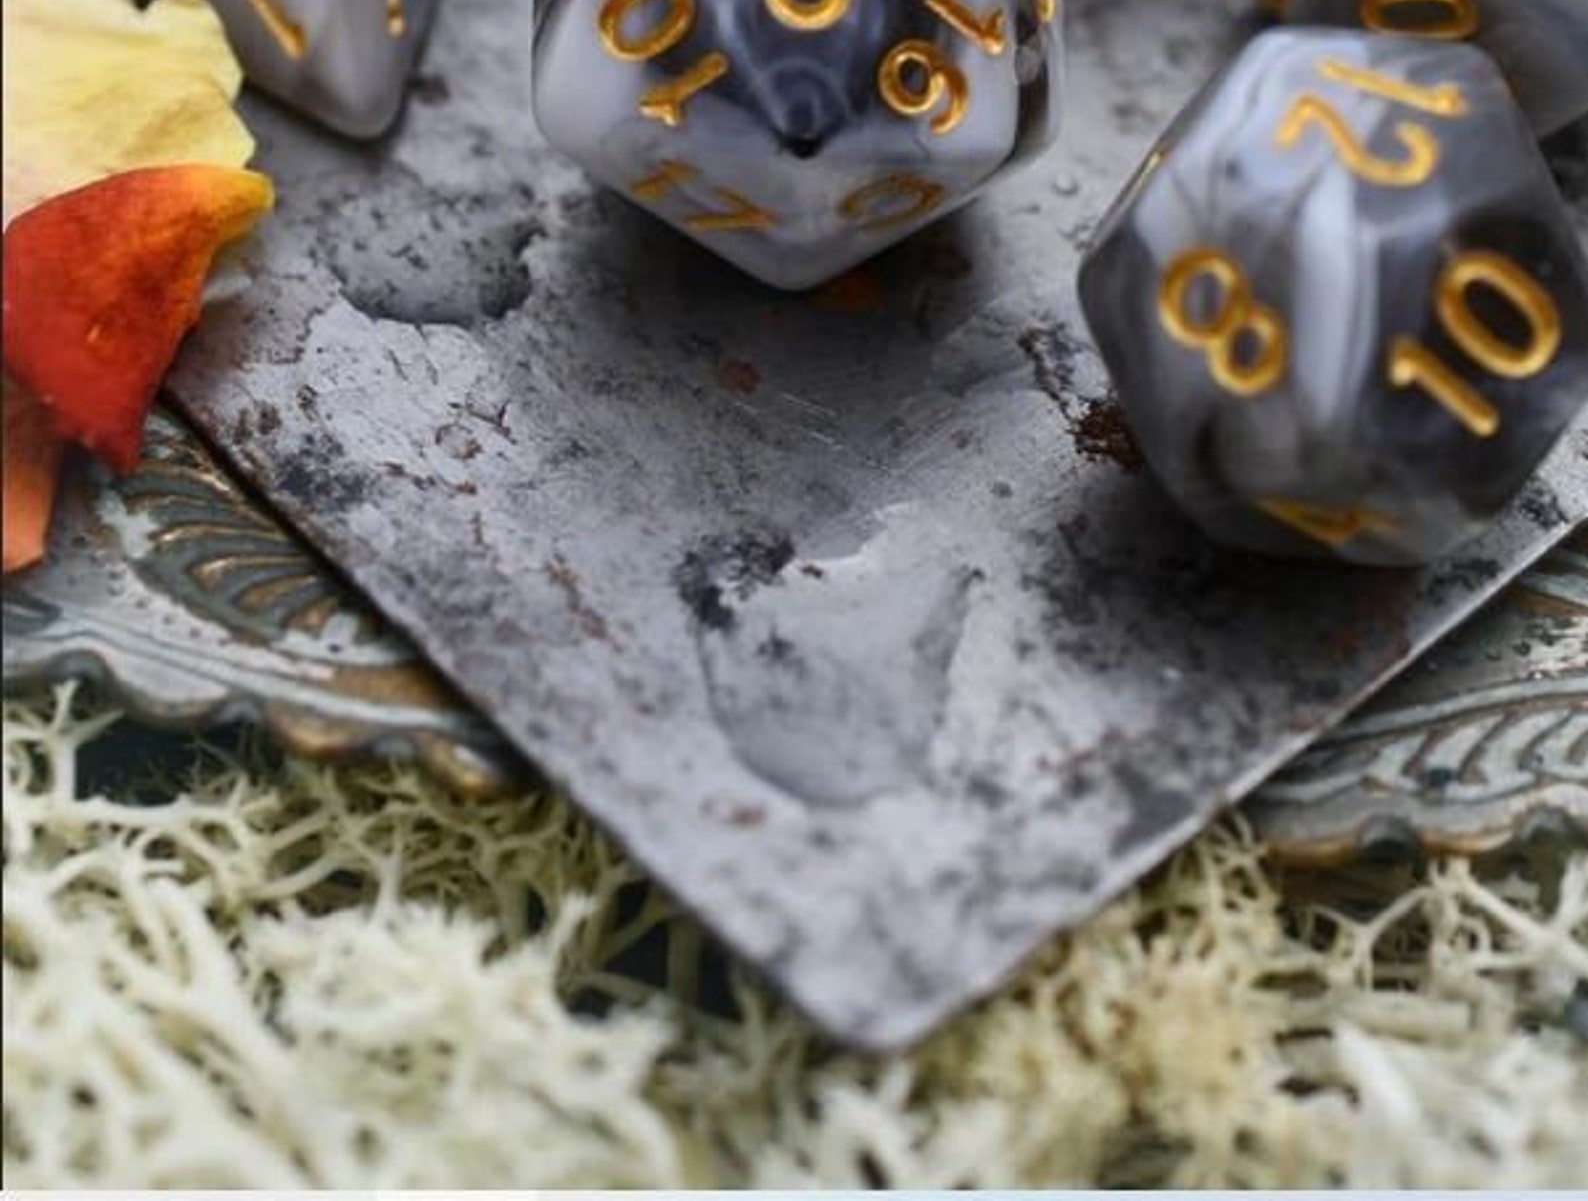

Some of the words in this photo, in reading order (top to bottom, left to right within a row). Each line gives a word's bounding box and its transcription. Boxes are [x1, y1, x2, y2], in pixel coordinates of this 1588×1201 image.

[1272, 55, 1468, 189] 12
[1157, 246, 1286, 399] 8
[1388, 247, 1564, 439] 10
